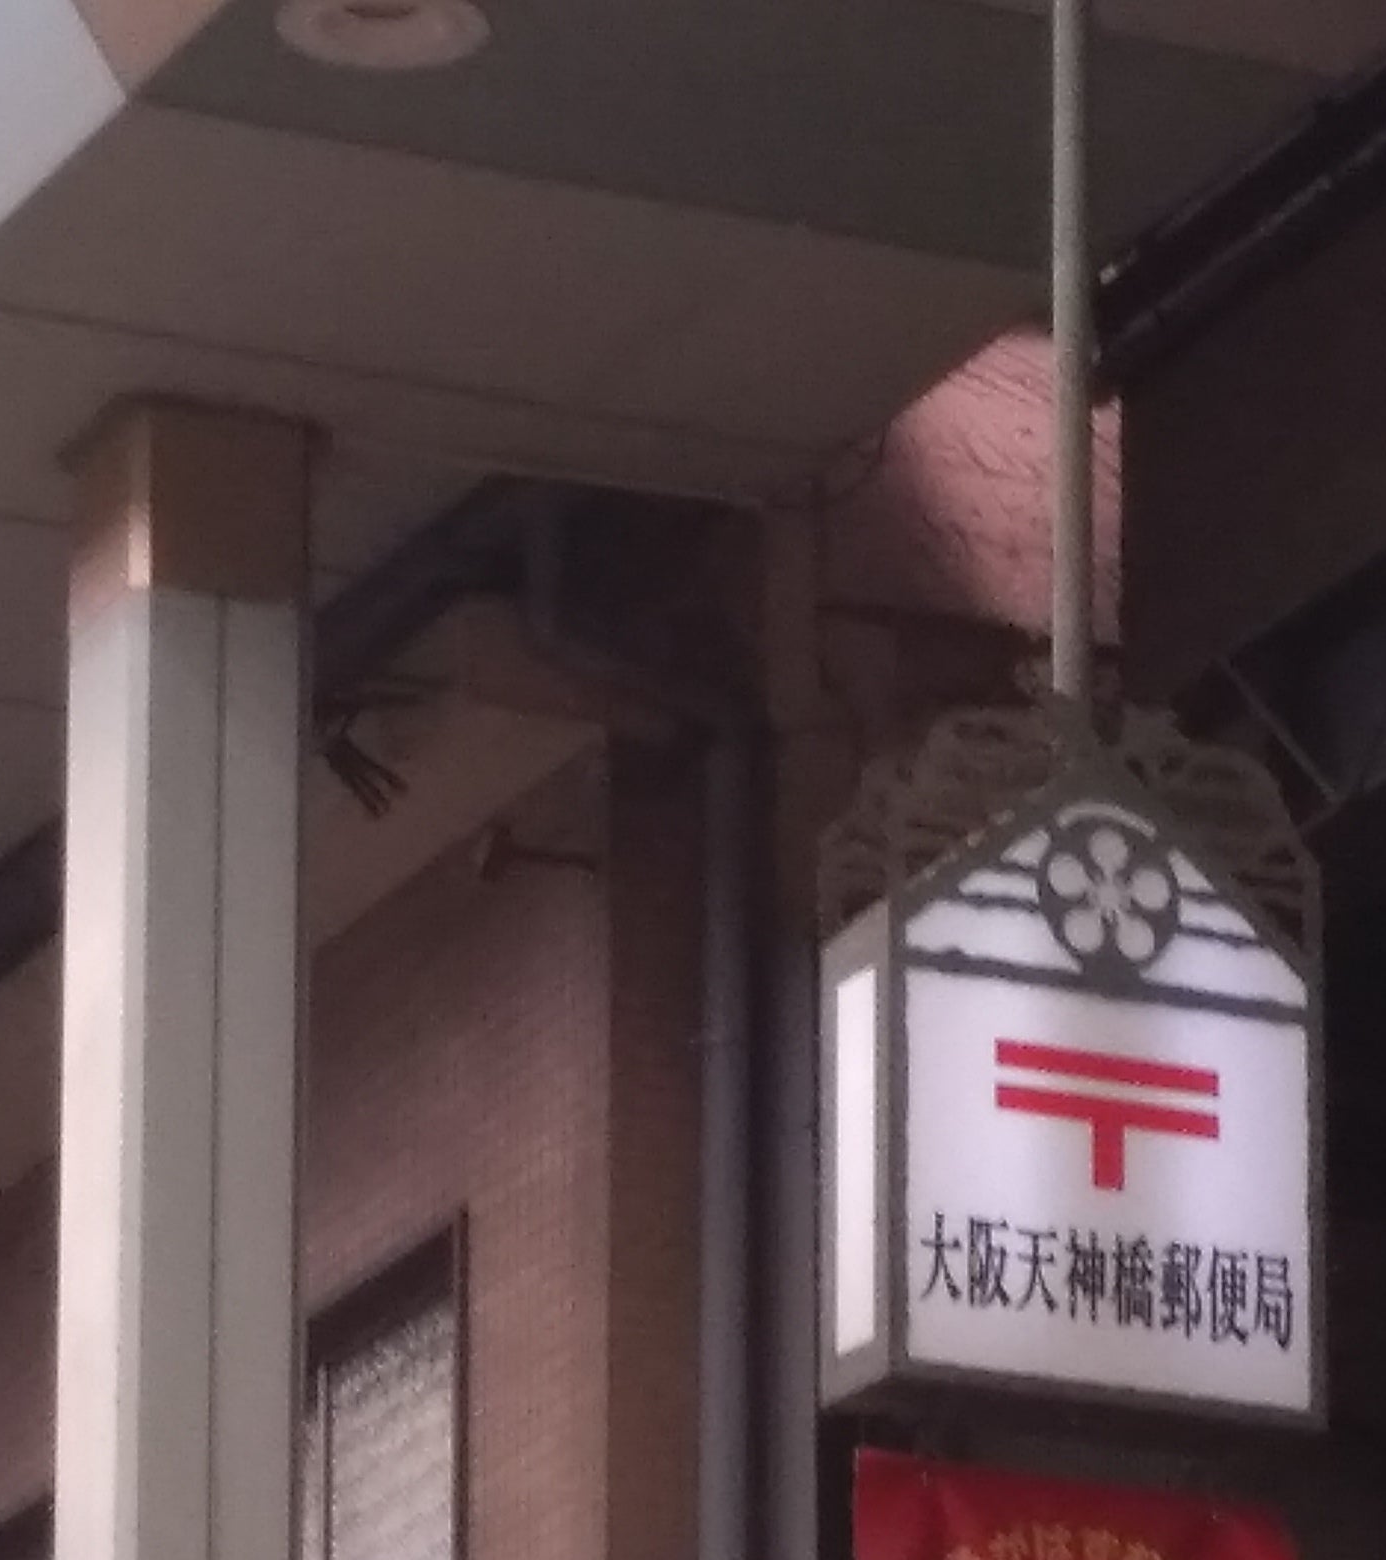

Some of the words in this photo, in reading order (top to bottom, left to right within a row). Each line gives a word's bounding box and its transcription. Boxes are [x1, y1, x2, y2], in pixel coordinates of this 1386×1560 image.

[920, 1211, 1294, 1350] 大阪天神橋郵便局
